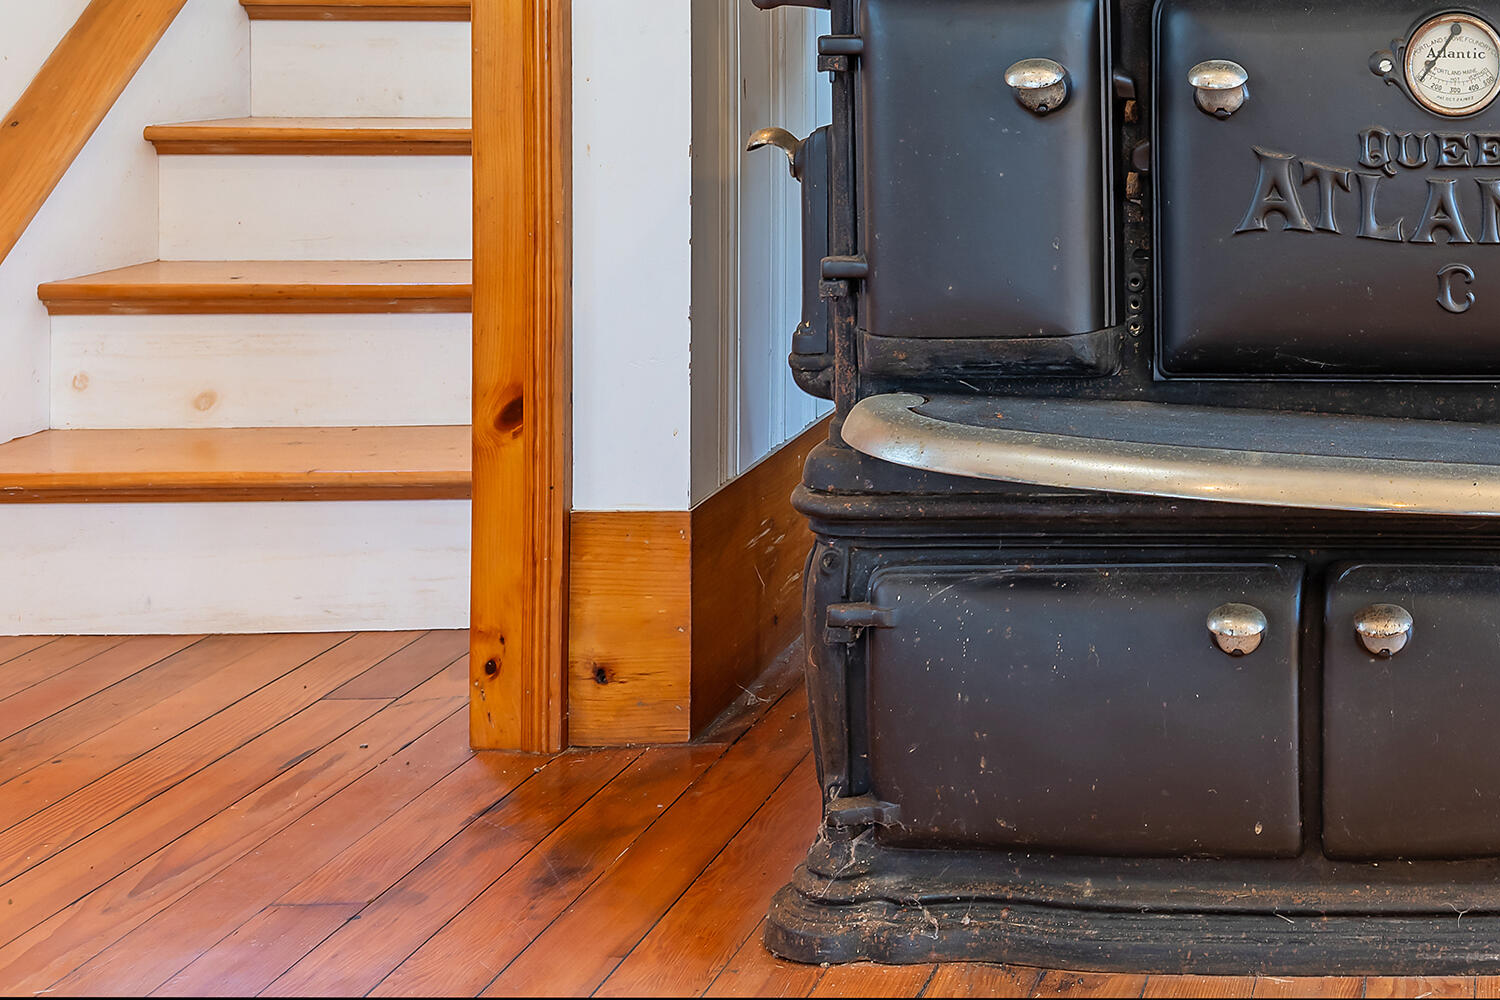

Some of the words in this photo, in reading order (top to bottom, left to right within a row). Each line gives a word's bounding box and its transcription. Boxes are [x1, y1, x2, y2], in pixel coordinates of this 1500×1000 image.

[1430, 83, 1442, 91] 200
[1468, 83, 1479, 91] 400
[1436, 262, 1476, 314] C
